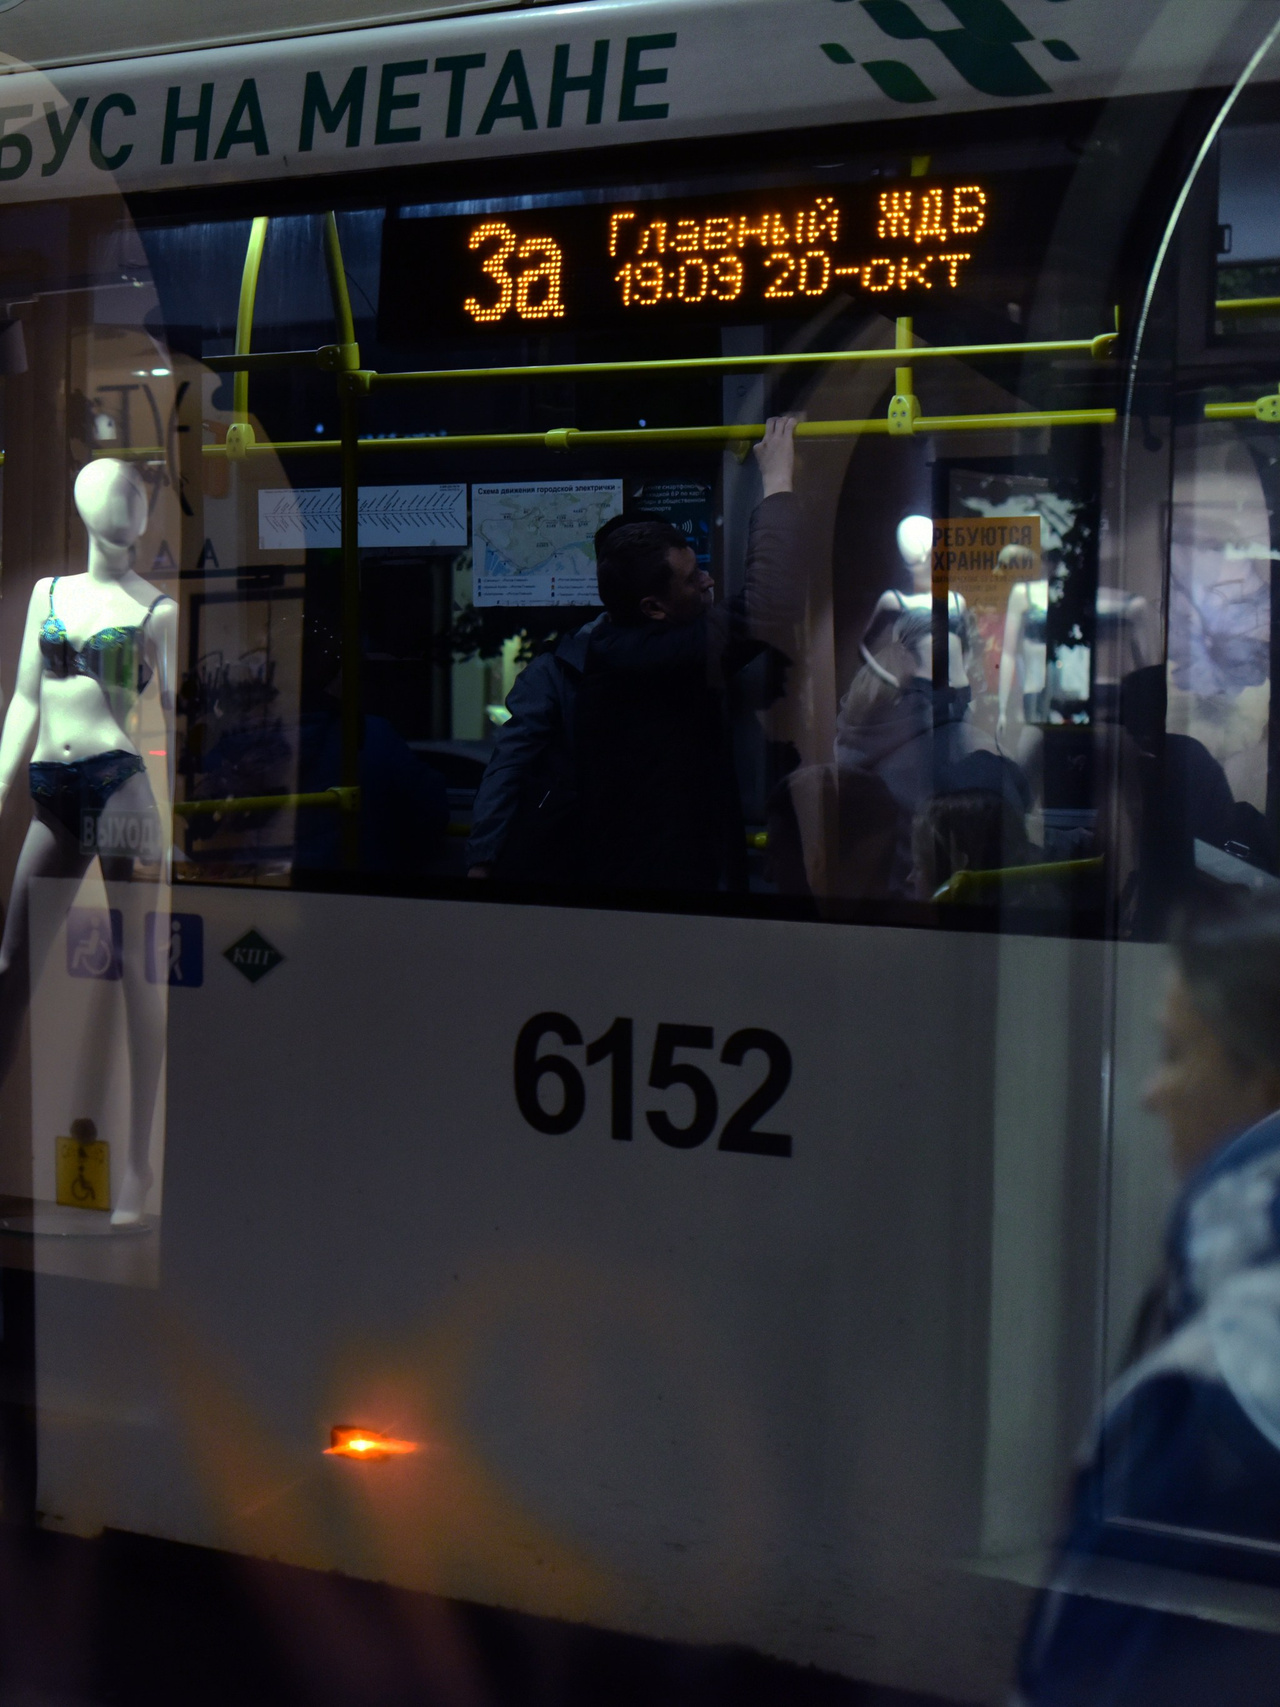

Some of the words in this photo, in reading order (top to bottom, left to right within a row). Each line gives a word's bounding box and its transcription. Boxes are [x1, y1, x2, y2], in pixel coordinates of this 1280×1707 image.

[159, 77, 271, 166] НА
[297, 31, 678, 153] МЕТАНЕ
[607, 196, 841, 258] Главный
[876, 185, 987, 244] ЖДВ
[613, 255, 744, 307] 19:09
[764, 250, 972, 299] 20-окт
[477, 487, 500, 495] Схема
[500, 487, 535, 496] движения
[536, 485, 574, 494] городской
[574, 484, 616, 493] электрички
[83, 815, 158, 850] ВЫХОД
[232, 946, 272, 967] КПГ
[514, 1011, 793, 1158] 6152
